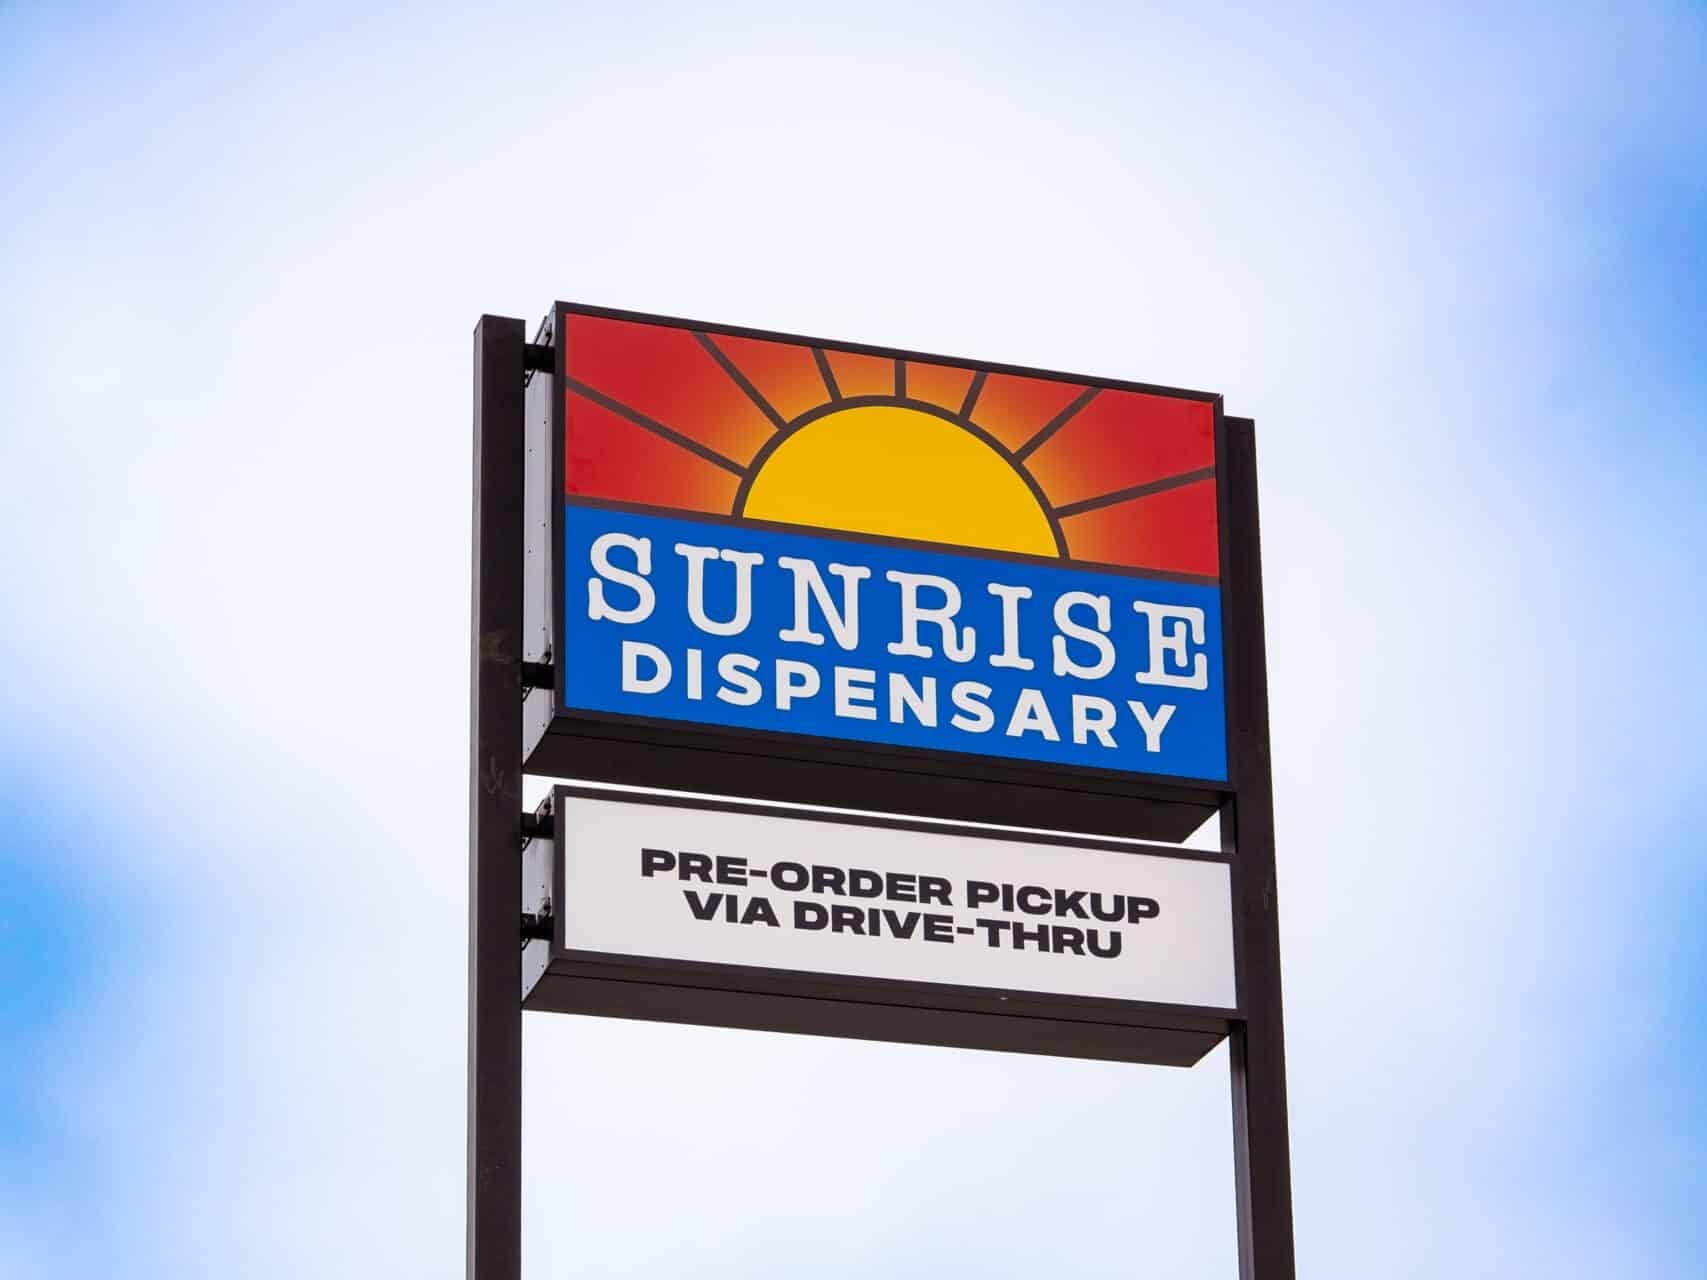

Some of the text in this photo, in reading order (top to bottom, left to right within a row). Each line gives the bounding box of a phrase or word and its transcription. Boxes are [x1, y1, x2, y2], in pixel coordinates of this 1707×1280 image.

[588, 533, 1208, 691] SUNRISE
[622, 640, 1177, 753] DISPENSARY
[641, 847, 1161, 925] PRE-ORDER PICKUP
[682, 889, 1122, 959] VIA DRIVE-THRU
